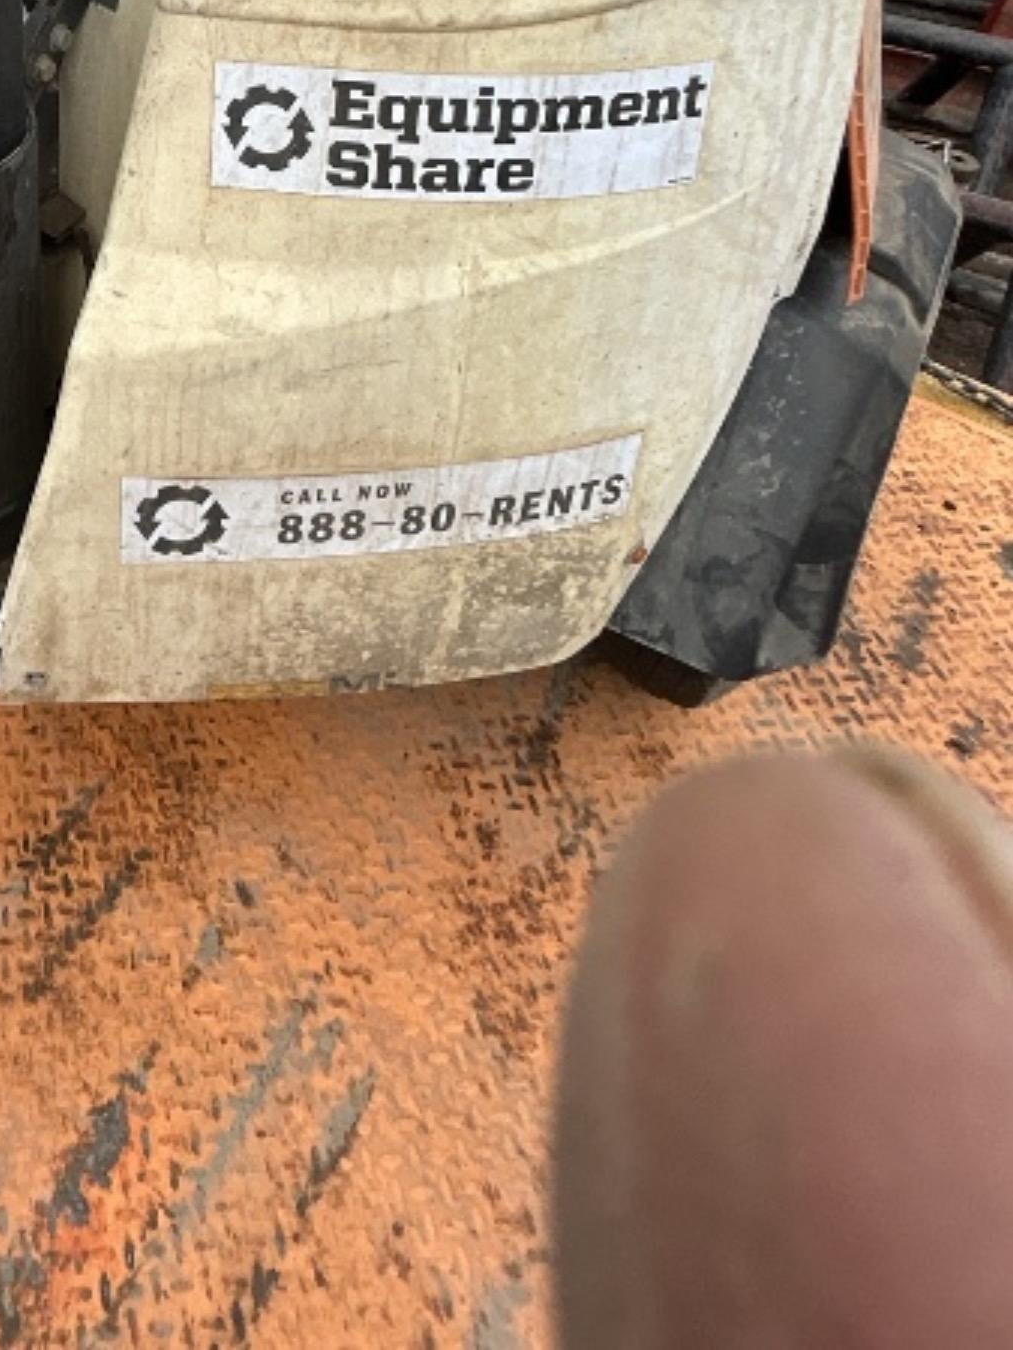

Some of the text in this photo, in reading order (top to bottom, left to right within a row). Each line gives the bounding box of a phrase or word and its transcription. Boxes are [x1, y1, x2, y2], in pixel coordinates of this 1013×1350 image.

[328, 74, 708, 145] Equipment
[326, 140, 536, 193] Share
[277, 473, 625, 545] 888-80-RENTS
[280, 481, 413, 505] CALL NOW
